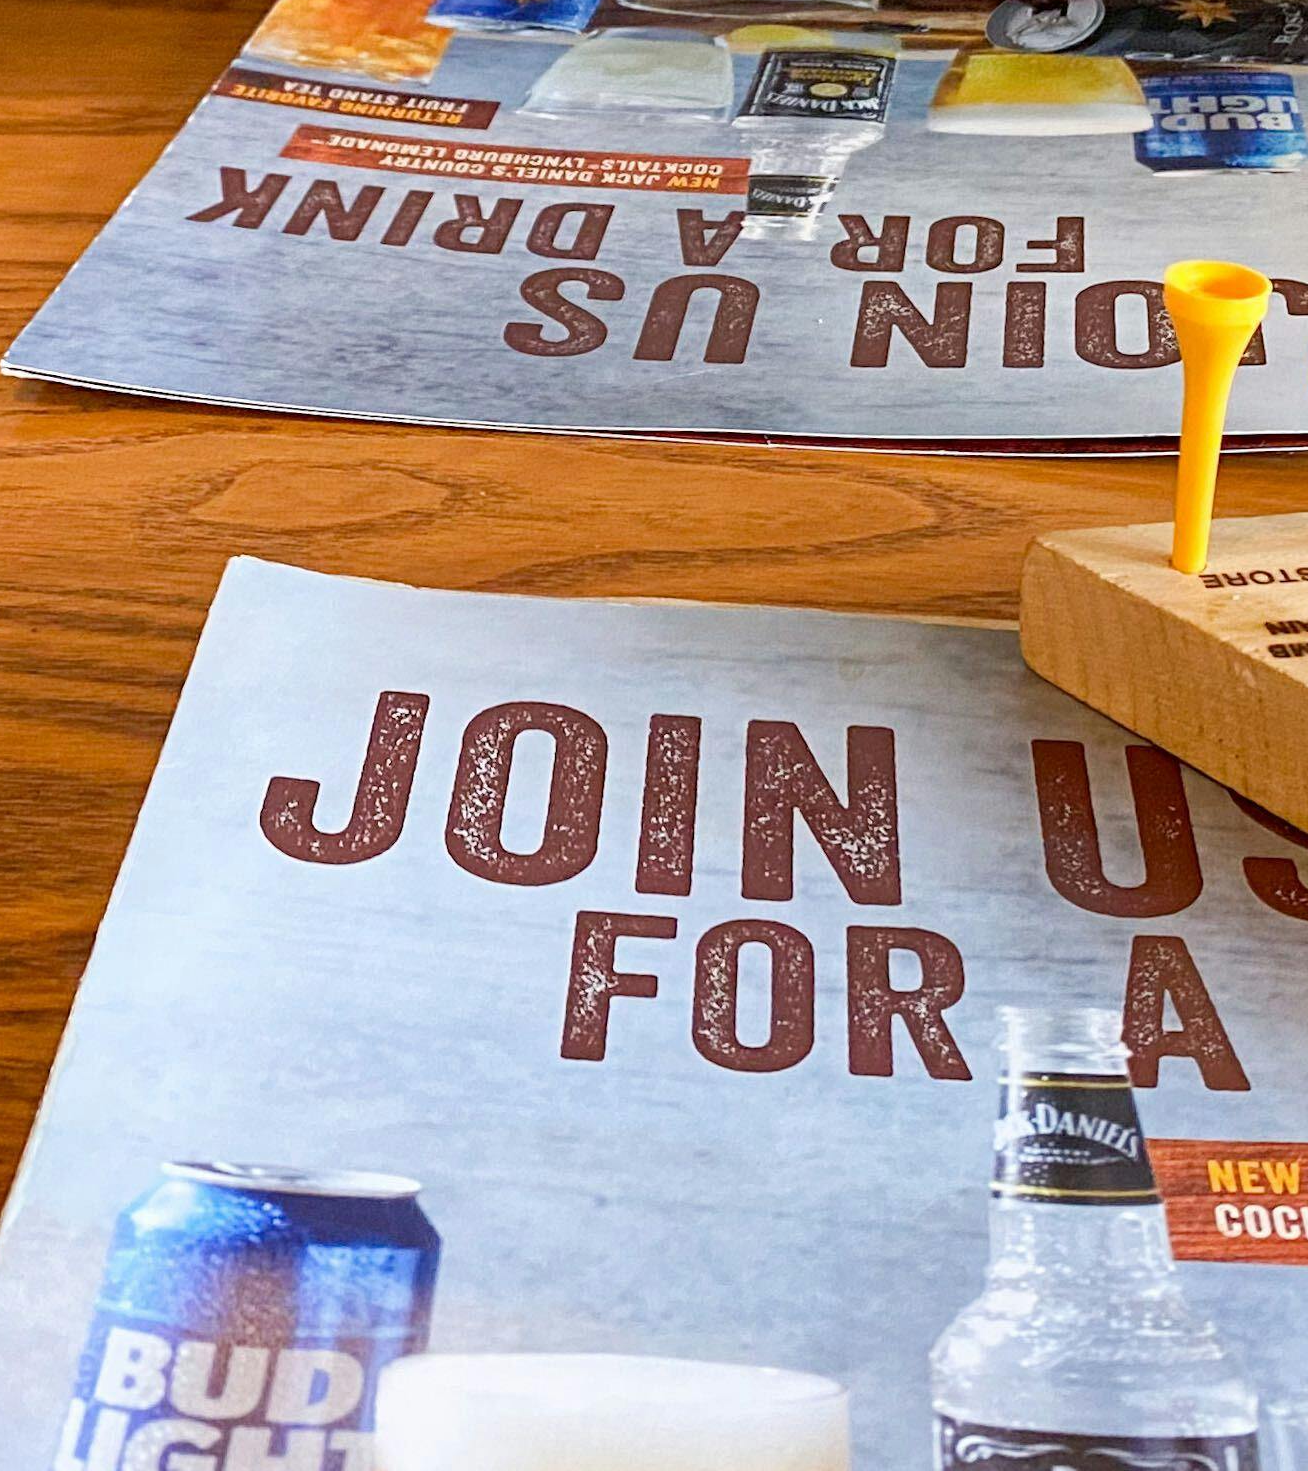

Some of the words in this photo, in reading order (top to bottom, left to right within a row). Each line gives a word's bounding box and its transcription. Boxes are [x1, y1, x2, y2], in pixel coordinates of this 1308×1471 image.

[283, 81, 321, 96] TEA
[330, 88, 404, 108] STAND
[409, 97, 469, 113] FRUIT
[1161, 112, 1294, 131] BUD
[379, 154, 485, 176] COUNTRY
[454, 148, 585, 169] LYNCHBURG
[603, 171, 660, 186] JACK
[667, 176, 719, 188] NEW
[183, 166, 615, 265] DRINK
[679, 207, 745, 264] A
[833, 215, 1084, 275] FOR
[503, 269, 756, 366] US
[260, 691, 902, 905] JOIN
[560, 910, 972, 1082] FOR
[1125, 935, 1250, 1091] A
[1208, 1160, 1299, 1194] NEW
[96, 1326, 363, 1426] BUD
